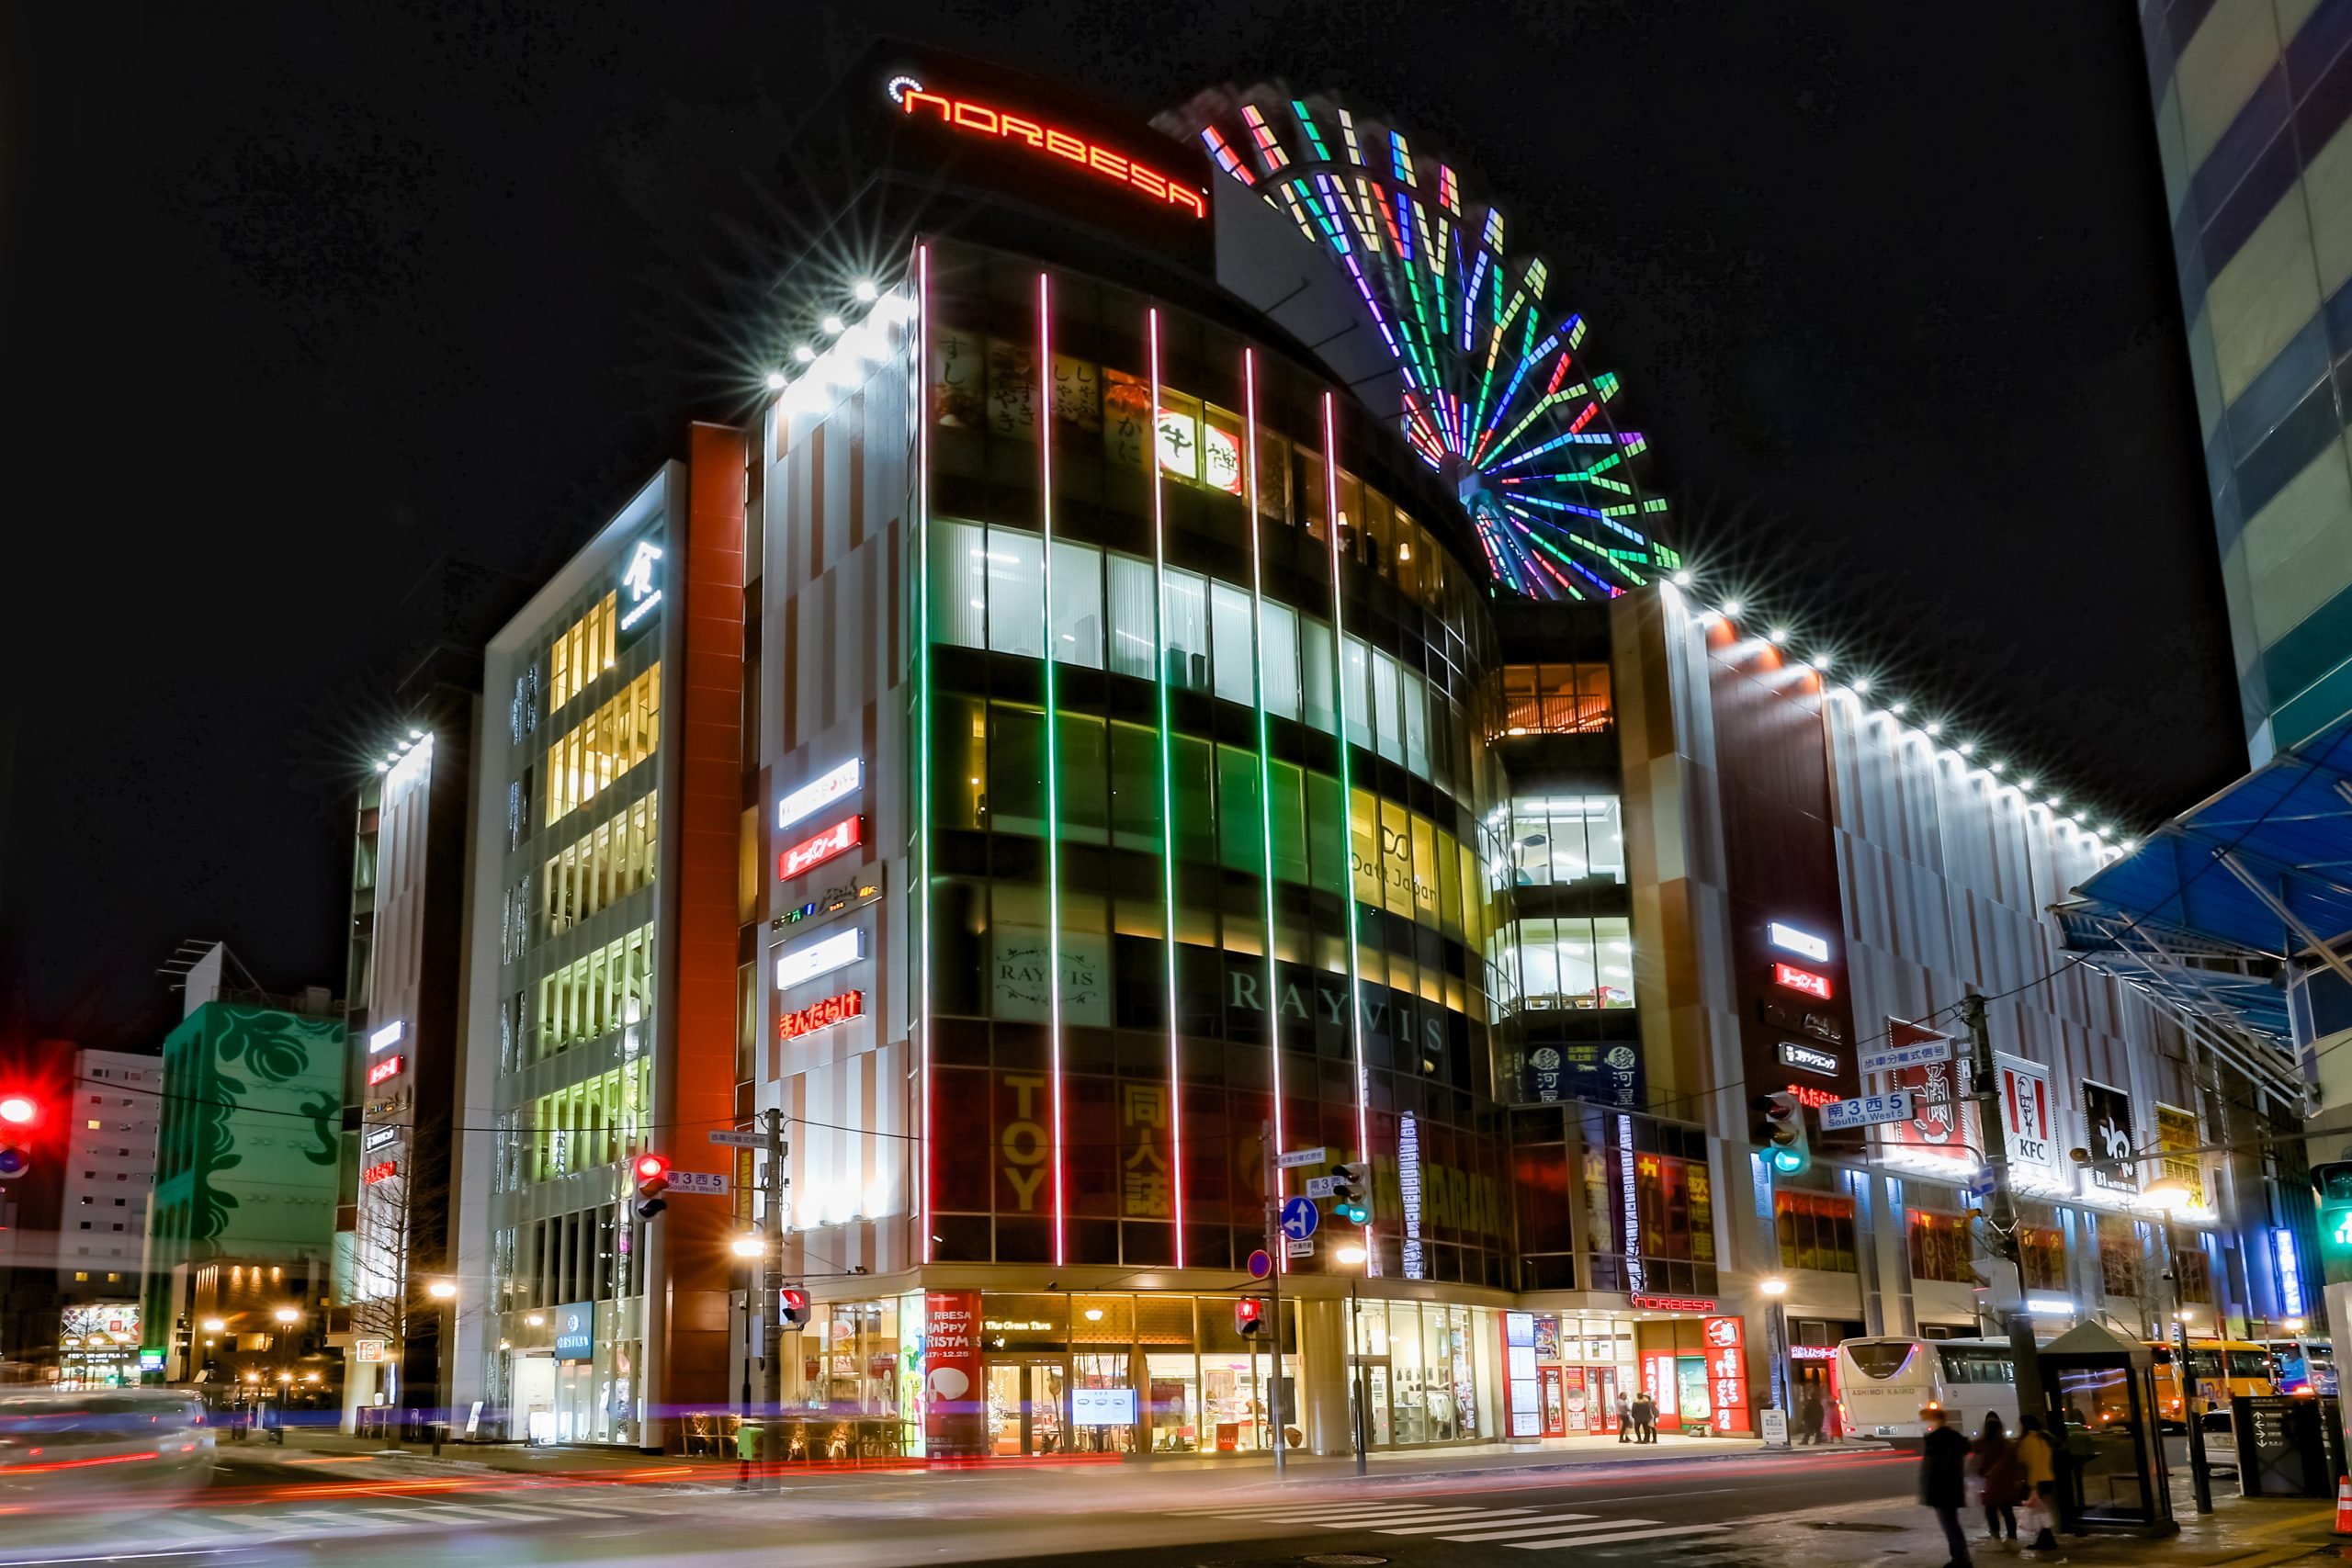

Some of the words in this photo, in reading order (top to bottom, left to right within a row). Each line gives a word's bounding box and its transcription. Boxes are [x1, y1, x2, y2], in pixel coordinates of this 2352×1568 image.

[904, 90, 1204, 218] NORBESA
[1001, 964, 1093, 986] RAYIS
[779, 989, 860, 1040] まんだらけ
[1229, 971, 1442, 1051] RAYVIS
[1865, 1045, 1945, 1068] 歩車分離式信号
[1829, 1116, 1857, 1127] South
[1870, 1111, 1894, 1121] West
[1001, 1076, 1048, 1212] TOY
[2019, 1138, 2044, 1160] KFC
[1635, 1297, 1716, 1312] NORBESA
